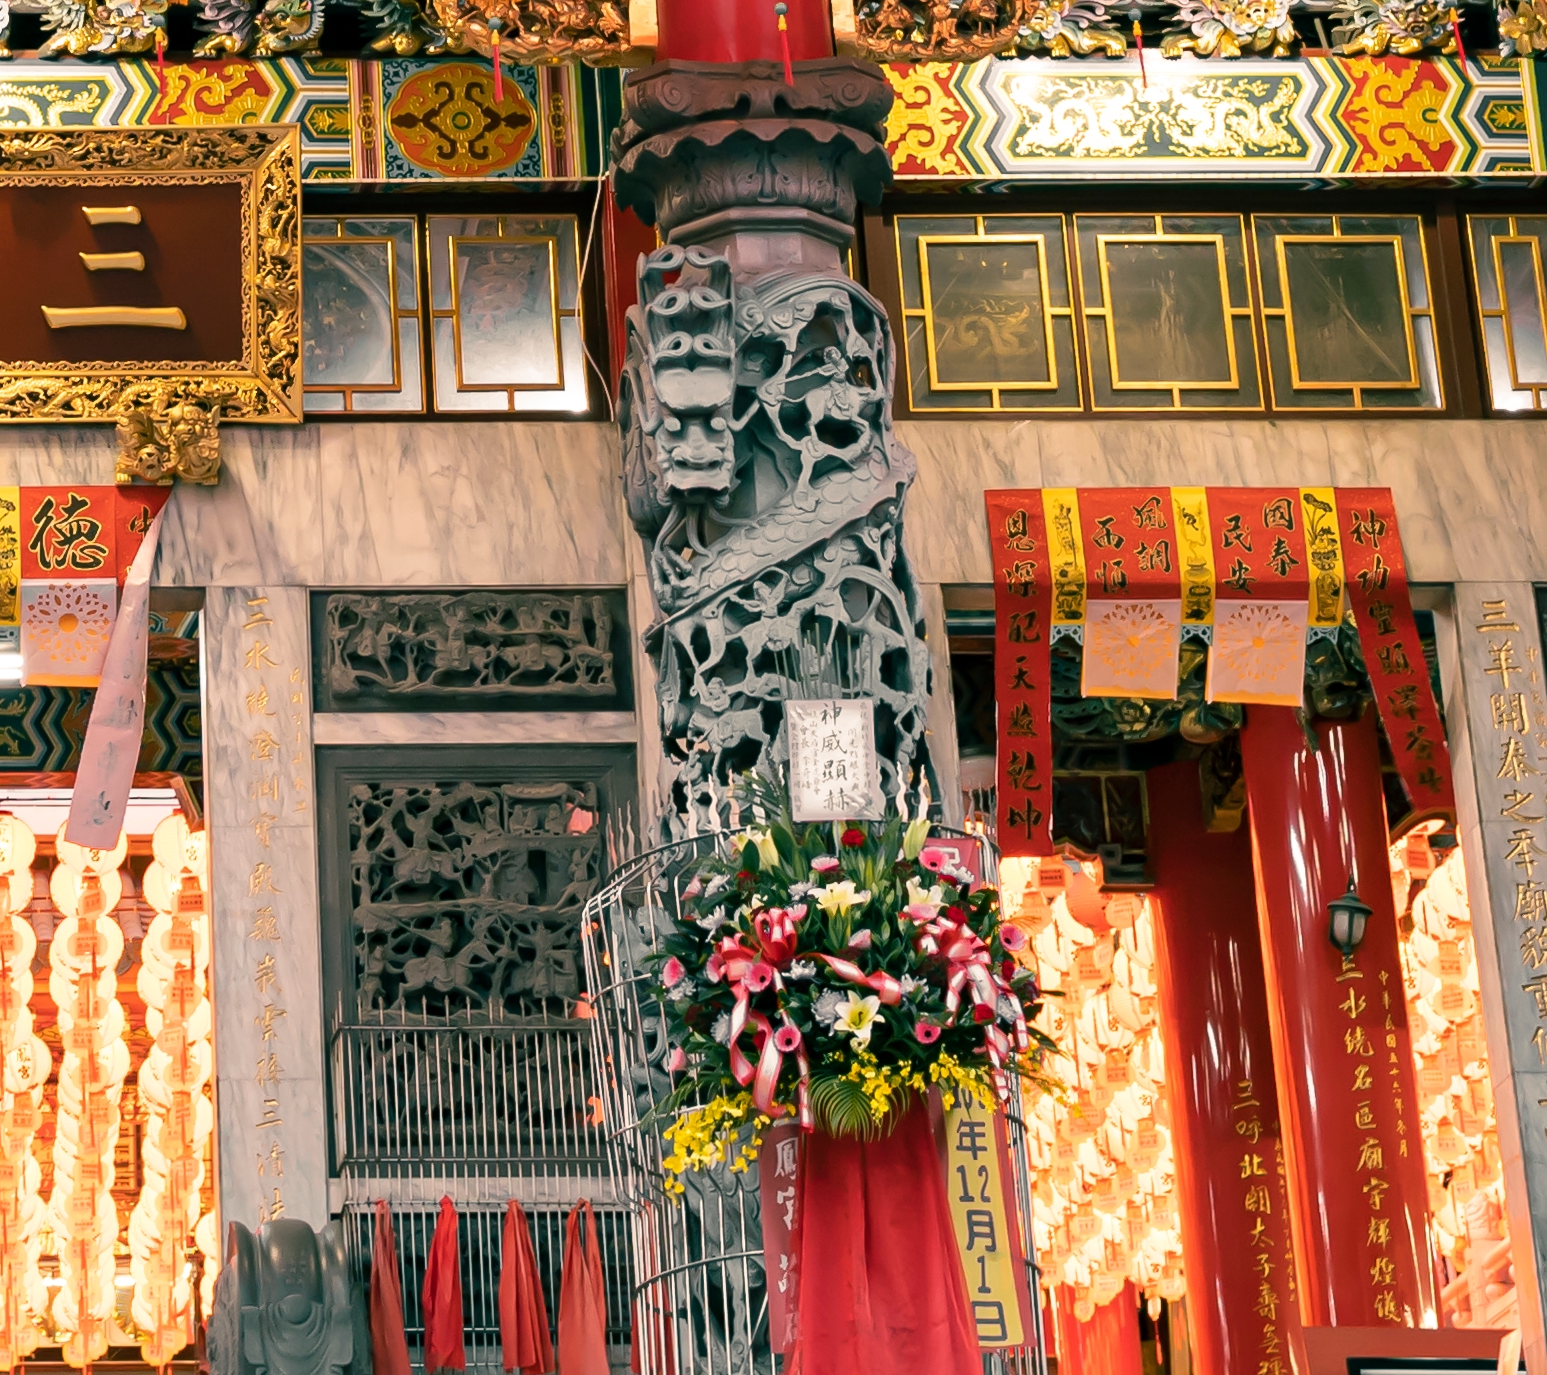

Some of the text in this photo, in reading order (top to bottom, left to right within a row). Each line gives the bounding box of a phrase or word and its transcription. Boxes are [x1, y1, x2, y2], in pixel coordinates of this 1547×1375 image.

[1092, 516, 1129, 595] 雨順
[1132, 495, 1173, 574] 風調
[1221, 513, 1258, 595] 民安
[1261, 496, 1300, 578] 國泰
[820, 700, 849, 812] 神威顯赫
[950, 1085, 1010, 1345] 10年12月1日
